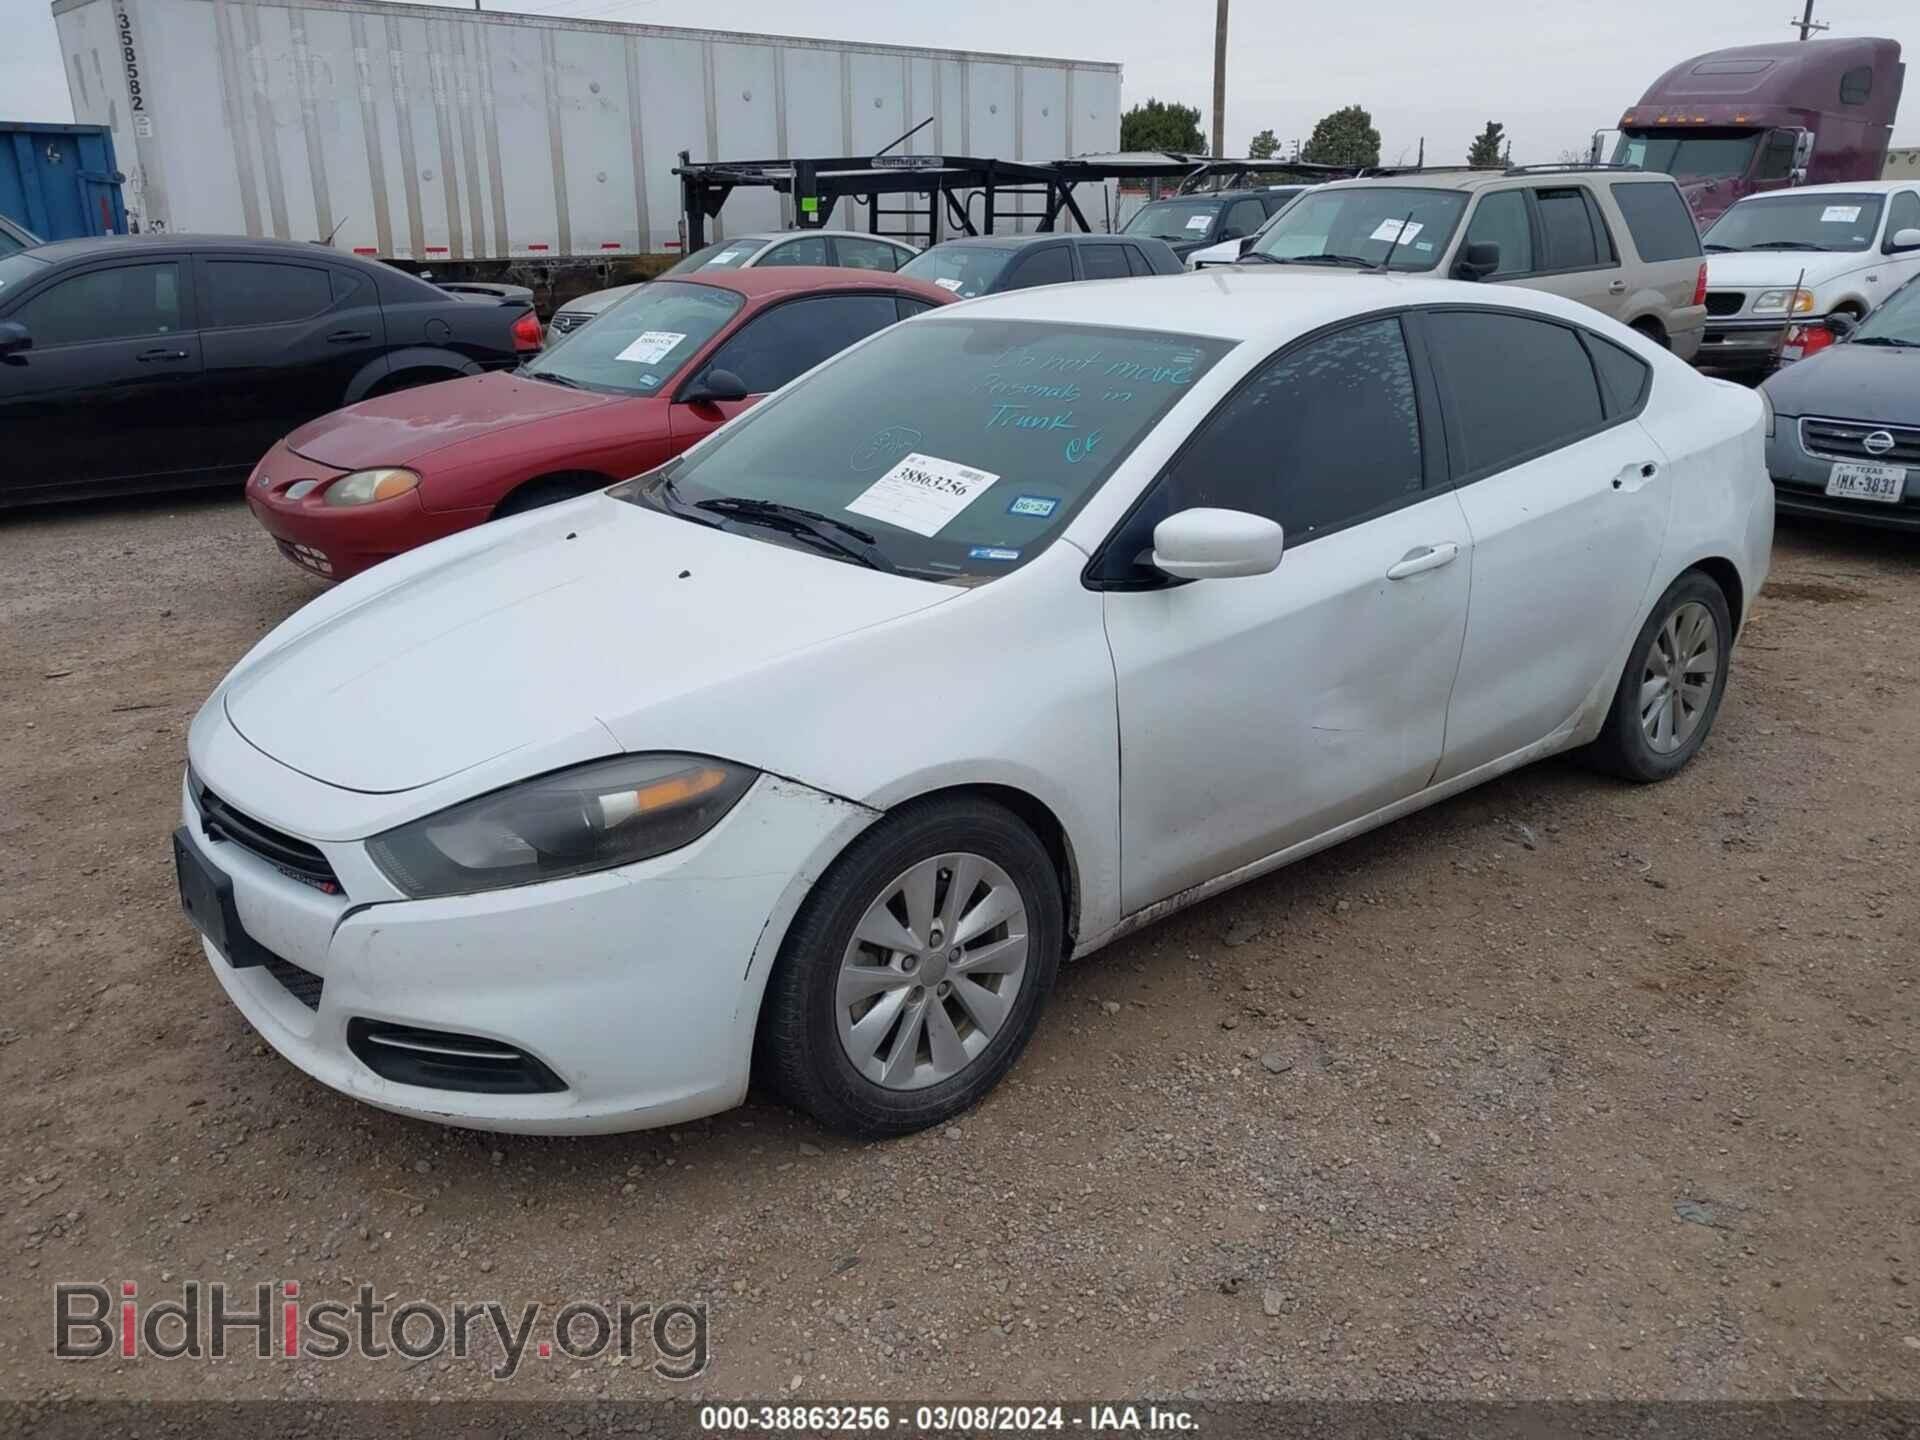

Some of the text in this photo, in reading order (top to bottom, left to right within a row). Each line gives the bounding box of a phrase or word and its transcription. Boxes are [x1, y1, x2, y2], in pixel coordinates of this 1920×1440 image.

[118, 13, 144, 111] 358582
[1040, 350, 1101, 370] not
[1104, 359, 1193, 385] move
[985, 403, 1080, 431] Trunk
[894, 467, 970, 497] 38863256
[1855, 465, 1884, 475] TEXAS
